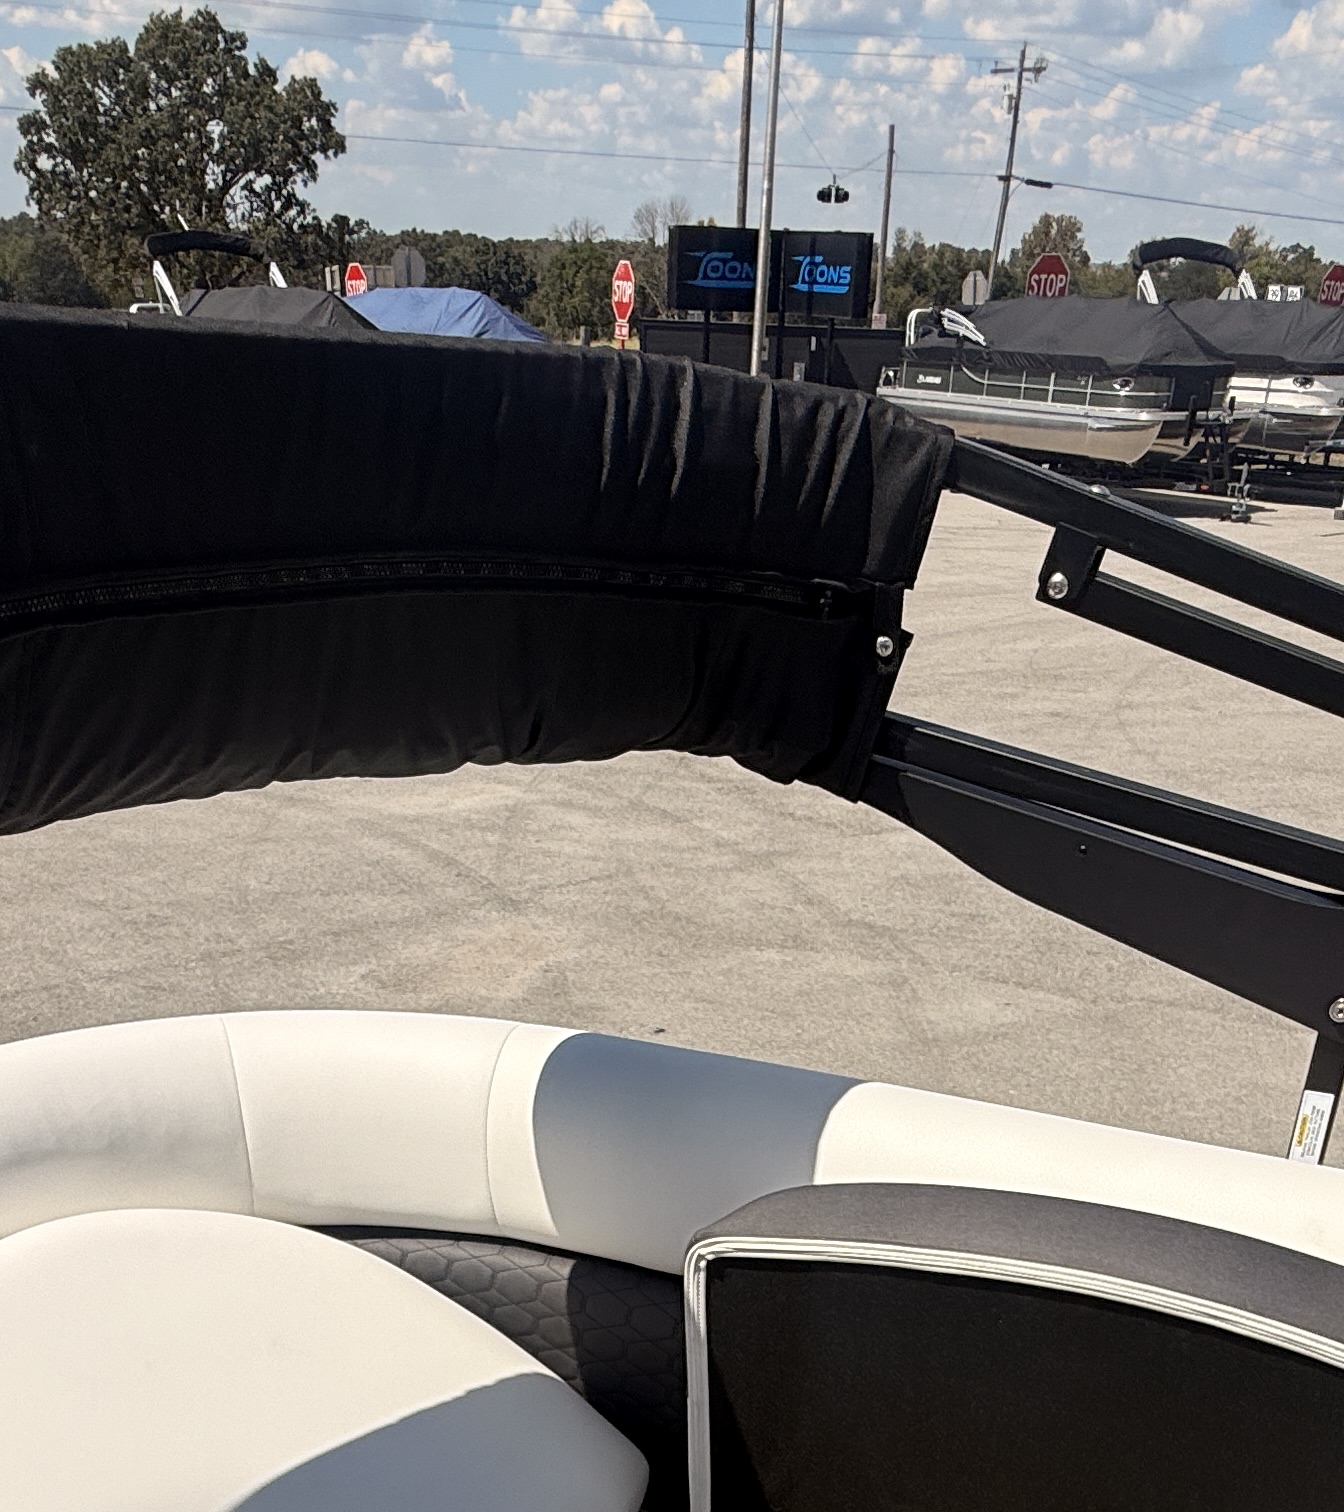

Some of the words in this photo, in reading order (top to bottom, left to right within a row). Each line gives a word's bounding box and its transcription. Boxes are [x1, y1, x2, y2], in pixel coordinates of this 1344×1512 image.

[792, 255, 852, 288] TOONS
[346, 279, 366, 297] STOP
[613, 280, 633, 303] STOP
[1028, 273, 1067, 297] STOP
